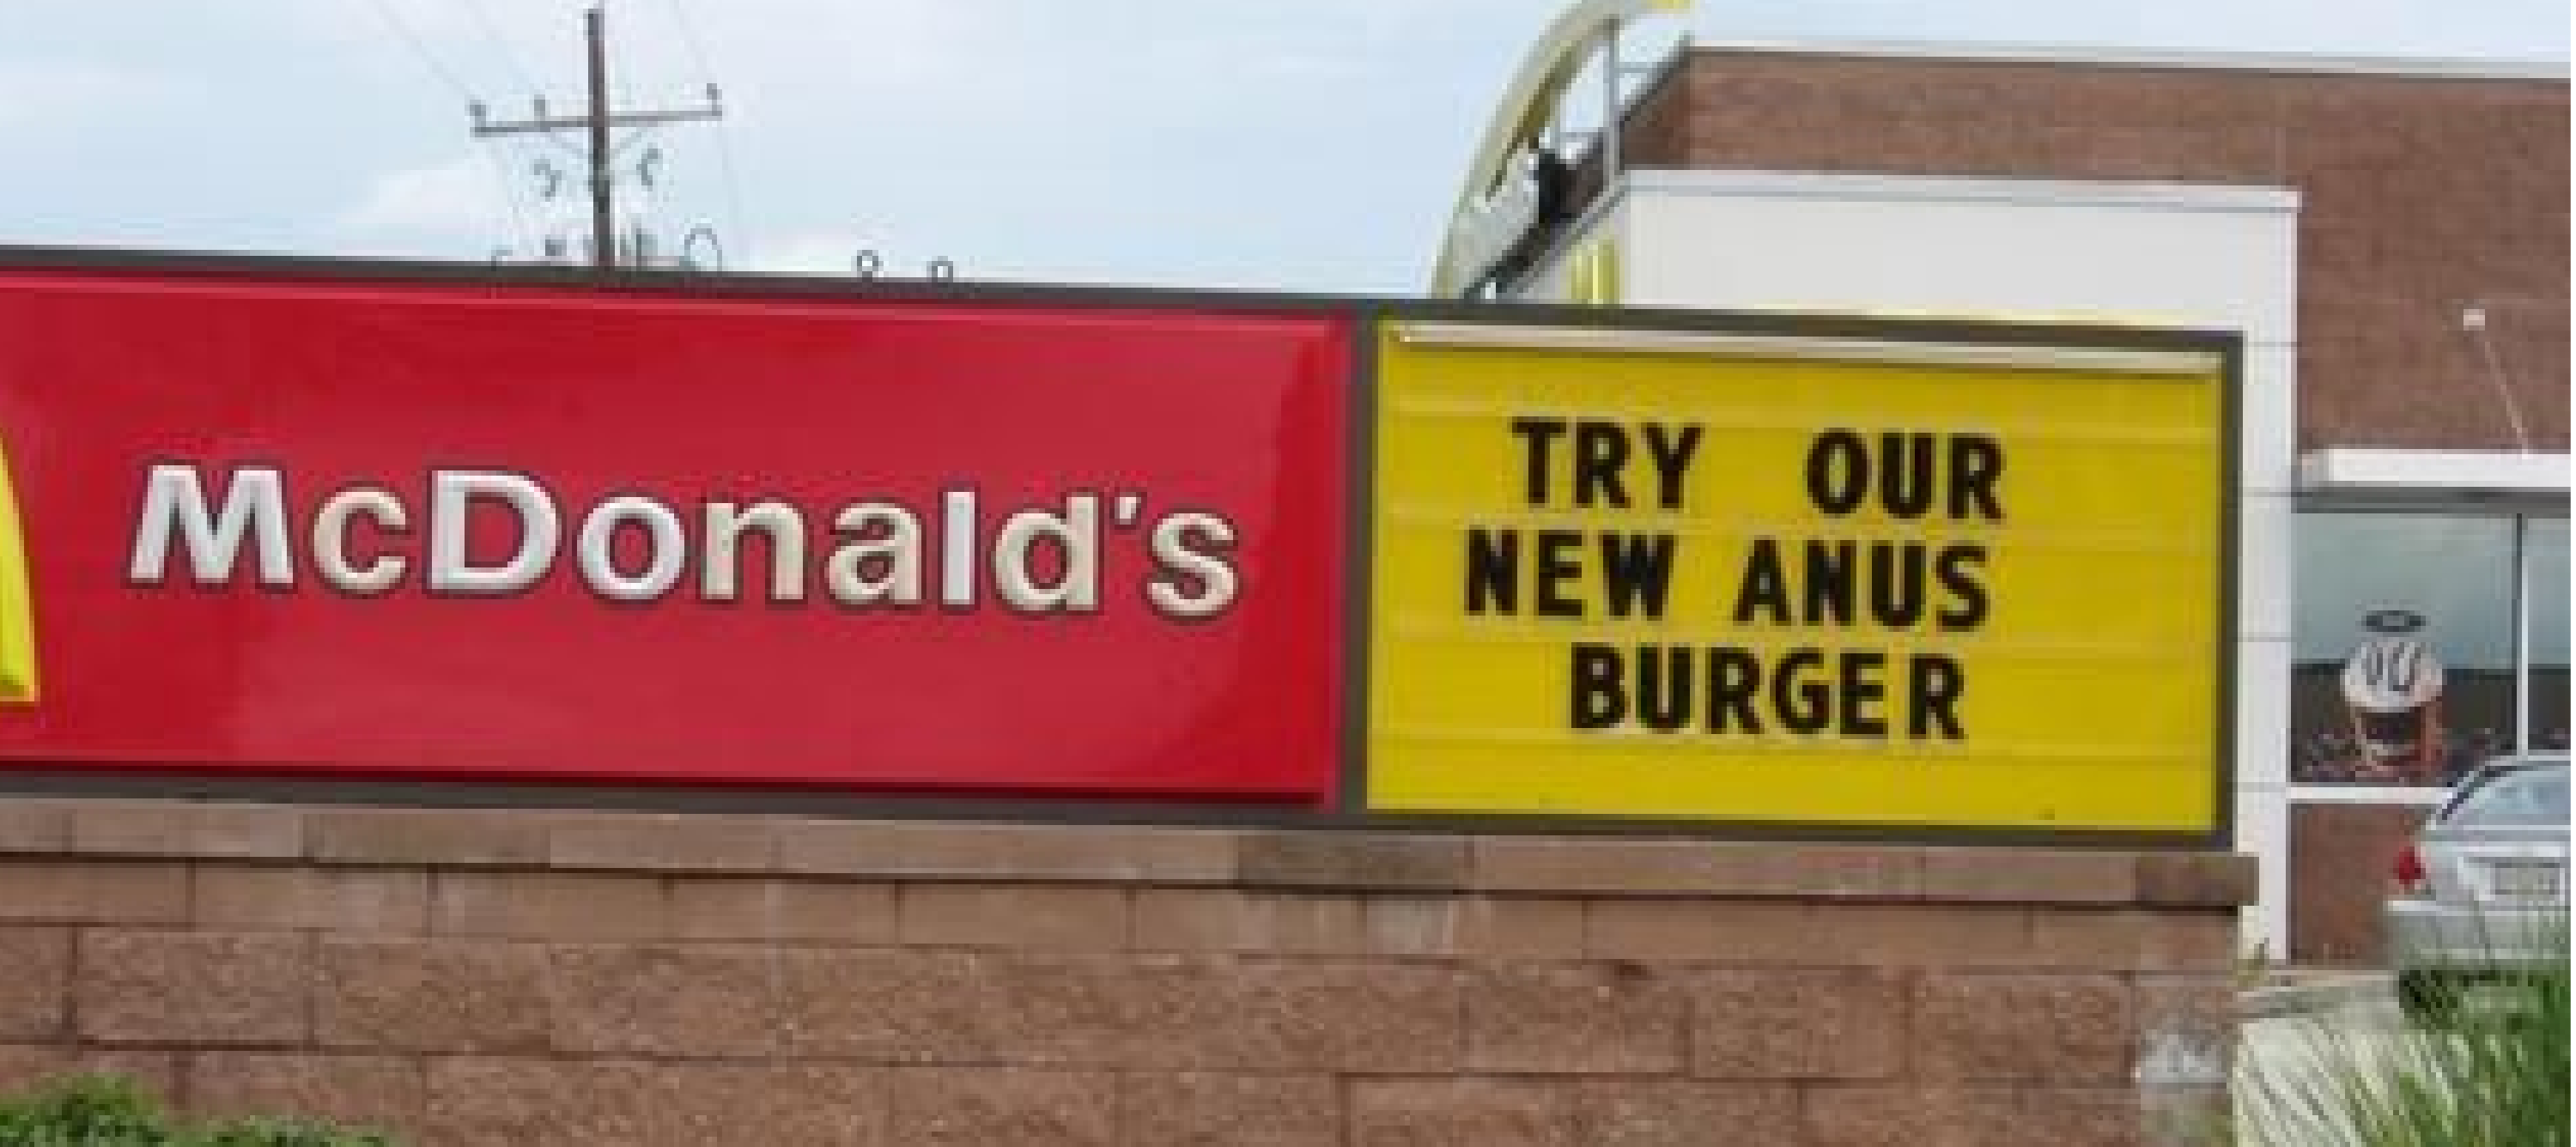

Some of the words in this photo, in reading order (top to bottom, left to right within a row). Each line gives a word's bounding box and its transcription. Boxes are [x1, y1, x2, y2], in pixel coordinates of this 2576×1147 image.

[1510, 416, 1702, 510] TRY
[1805, 429, 2008, 521] OUR
[128, 463, 1240, 618] McDonald's
[1465, 528, 1676, 622] NEW
[1733, 538, 1991, 631] ANUS
[1570, 642, 1966, 740] BURGER
